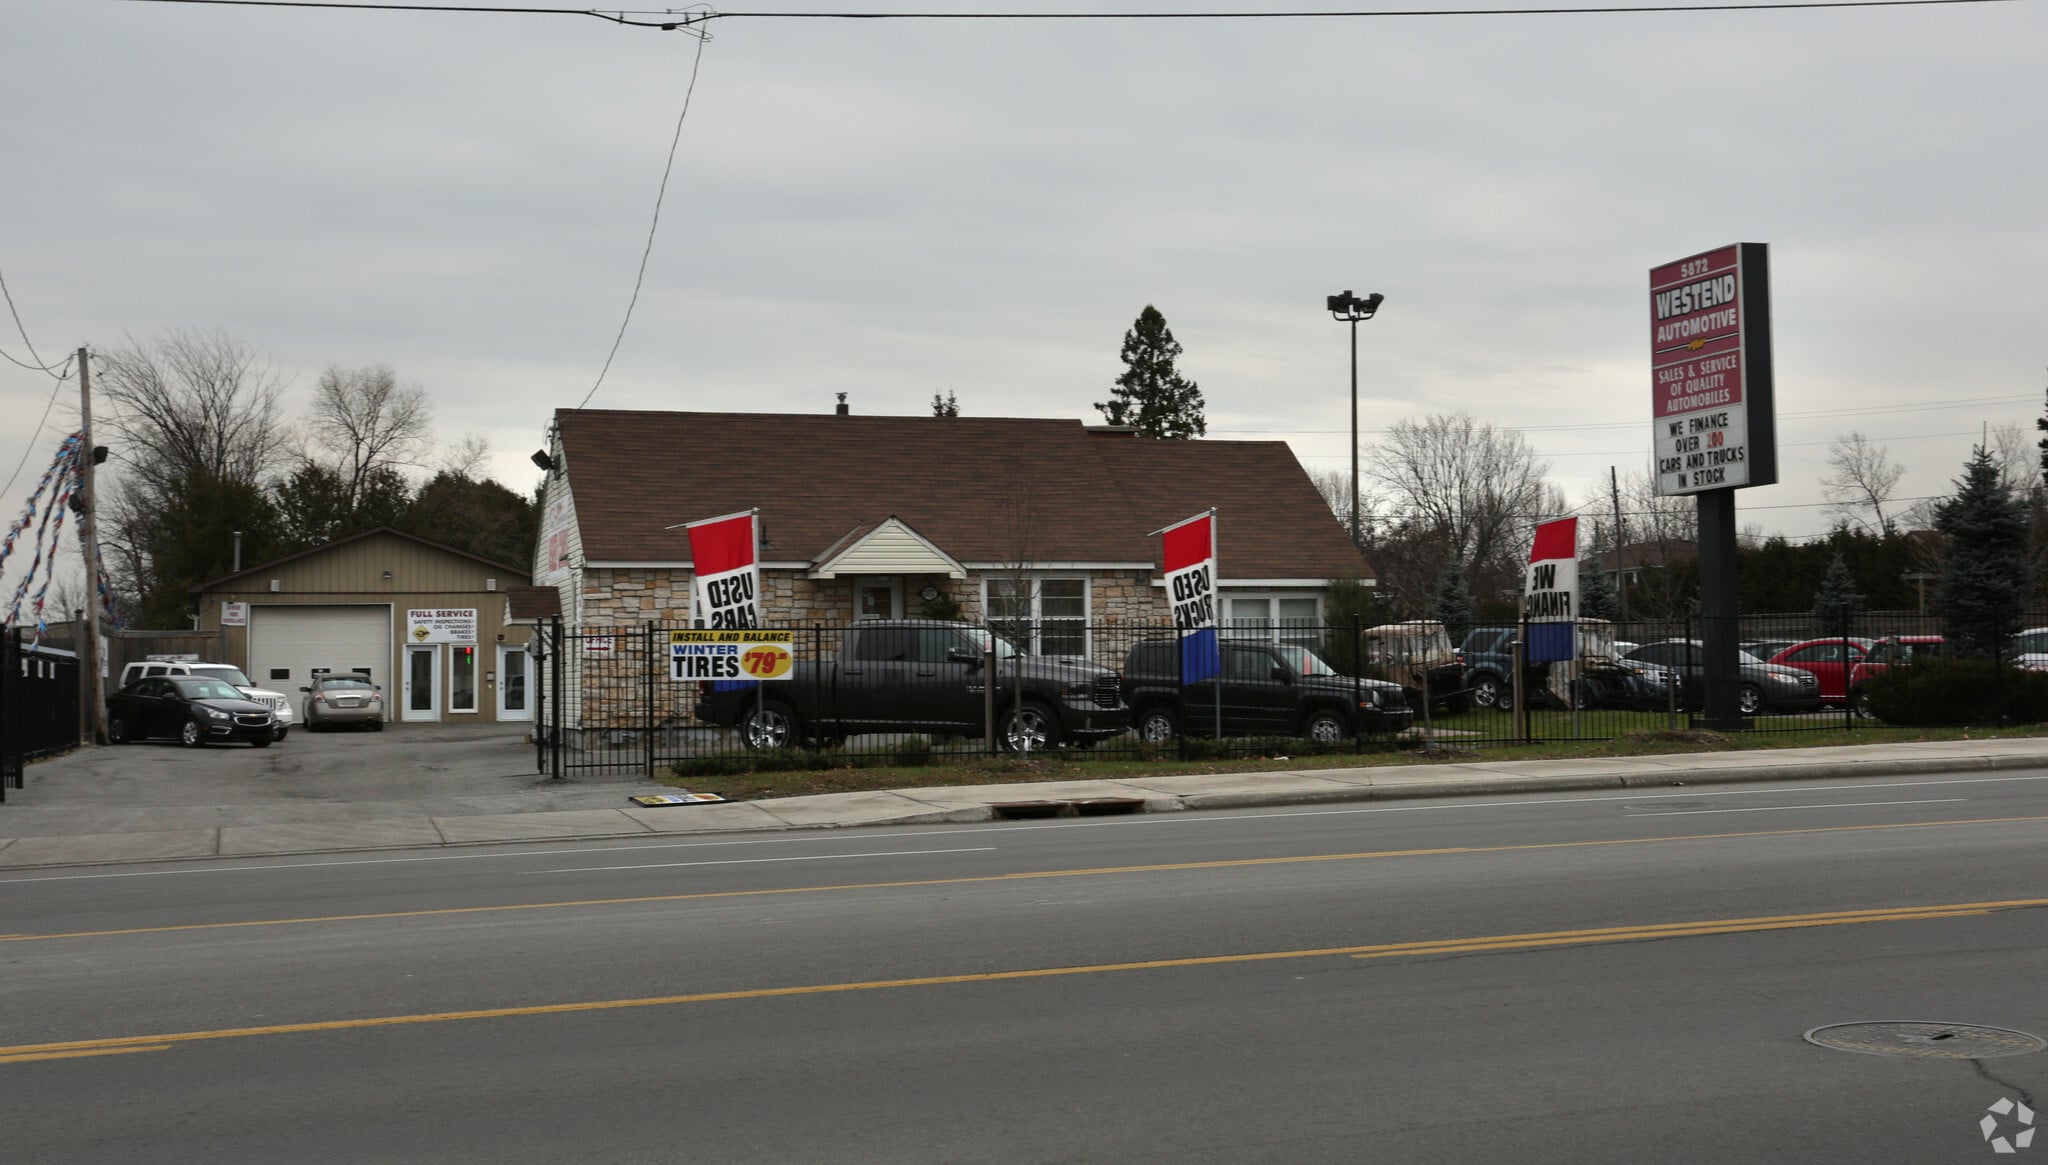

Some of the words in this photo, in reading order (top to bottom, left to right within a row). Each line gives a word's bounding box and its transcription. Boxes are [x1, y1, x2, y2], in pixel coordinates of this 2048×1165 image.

[1680, 258, 1709, 277] 5872
[1655, 274, 1736, 320] WESTEND
[1657, 308, 1737, 343] AUTOMOTIVE
[1658, 366, 1684, 384] SALES
[1688, 364, 1696, 377] &
[1700, 355, 1737, 375] SERVICE
[1670, 382, 1682, 396] OF
[1686, 373, 1725, 394] QUALITY
[1666, 388, 1731, 413] AUTOMOBILES
[1669, 421, 1683, 437] WE
[1689, 412, 1728, 433] FINANCE
[1675, 436, 1700, 453] OVER
[1706, 431, 1724, 448] 200
[1660, 456, 1682, 473] CARS
[1686, 453, 1705, 469] AND
[1707, 446, 1744, 466] TRUCKS
[1678, 473, 1687, 488] IN
[1693, 466, 1725, 486] STOCK
[410, 610, 433, 618] FULL
[436, 610, 474, 618] SERVICE
[672, 632, 715, 642] INSTALL
[718, 632, 740, 642] AND
[743, 632, 791, 642] BALANCE
[673, 644, 739, 655] WINTER
[673, 656, 740, 678] TIRES
